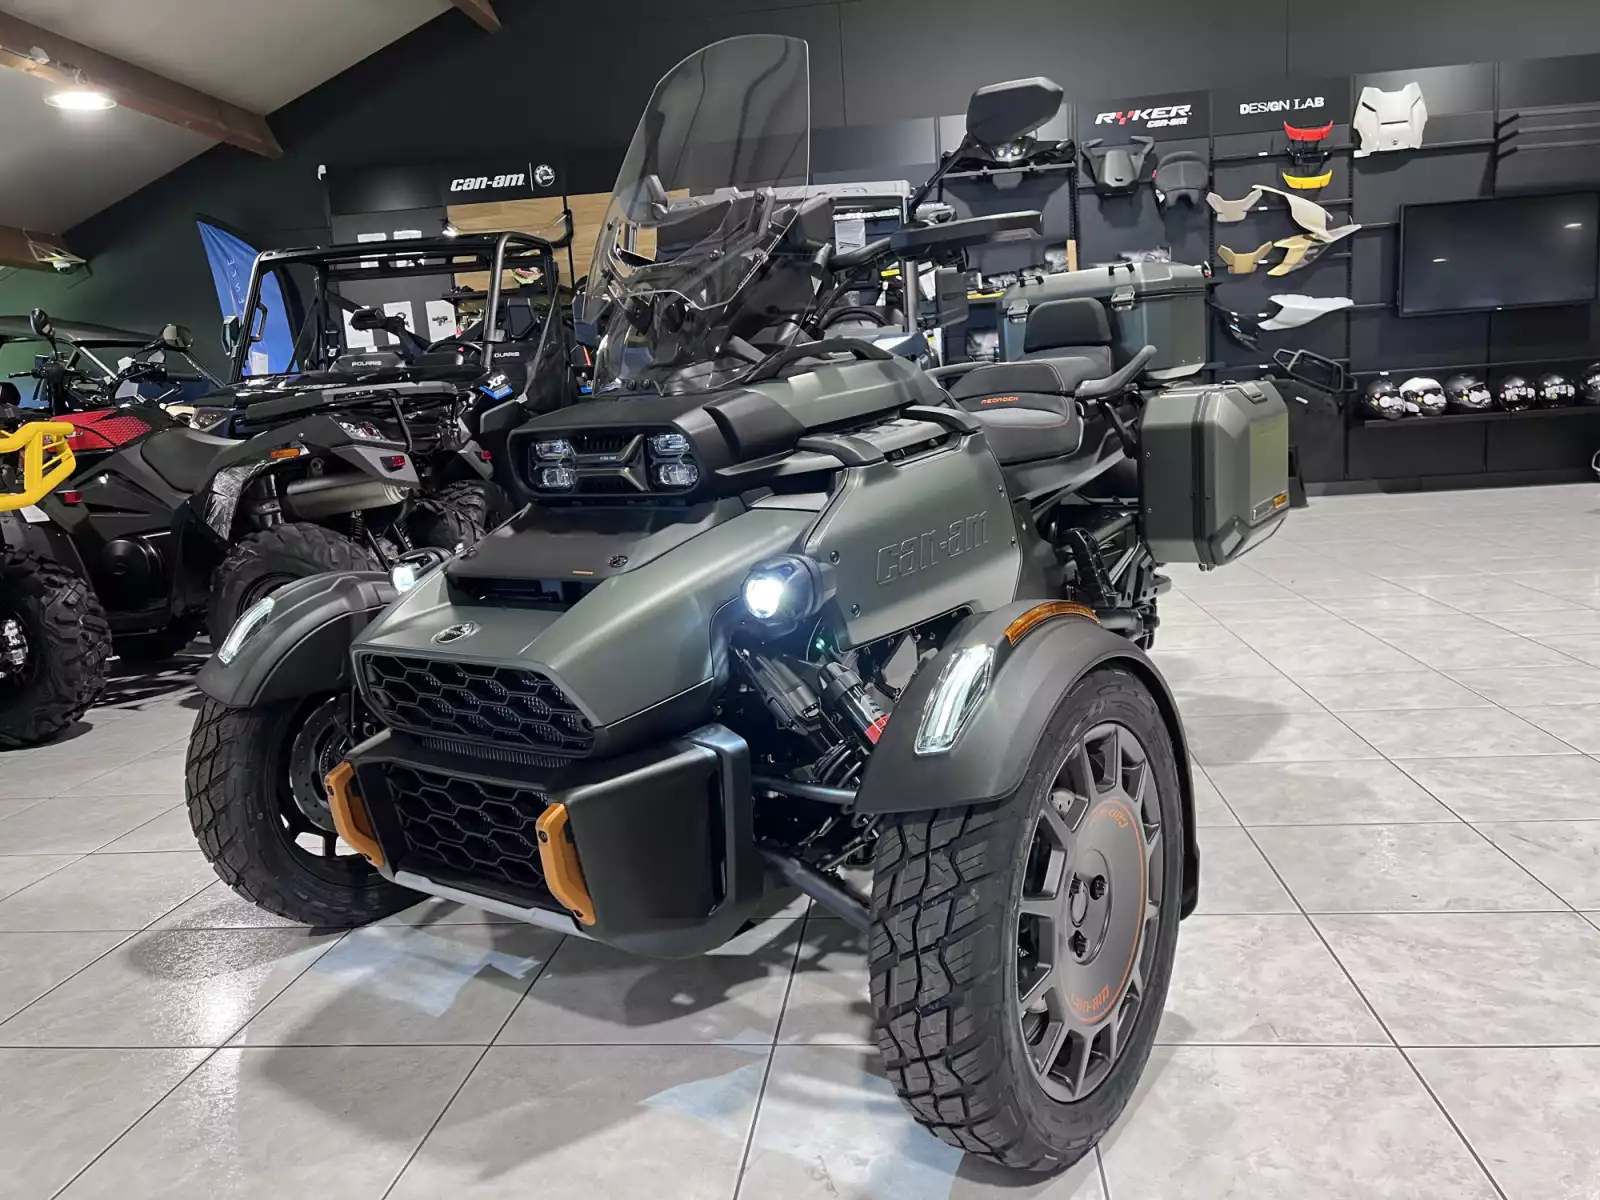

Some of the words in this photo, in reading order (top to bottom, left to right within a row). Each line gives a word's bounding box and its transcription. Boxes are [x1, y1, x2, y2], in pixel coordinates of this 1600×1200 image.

[1094, 104, 1191, 125] RYKER
[1239, 99, 1290, 115] DESIGN
[1293, 96, 1325, 110] LAB
[450, 173, 525, 192] can-am
[876, 510, 989, 585] can-am
